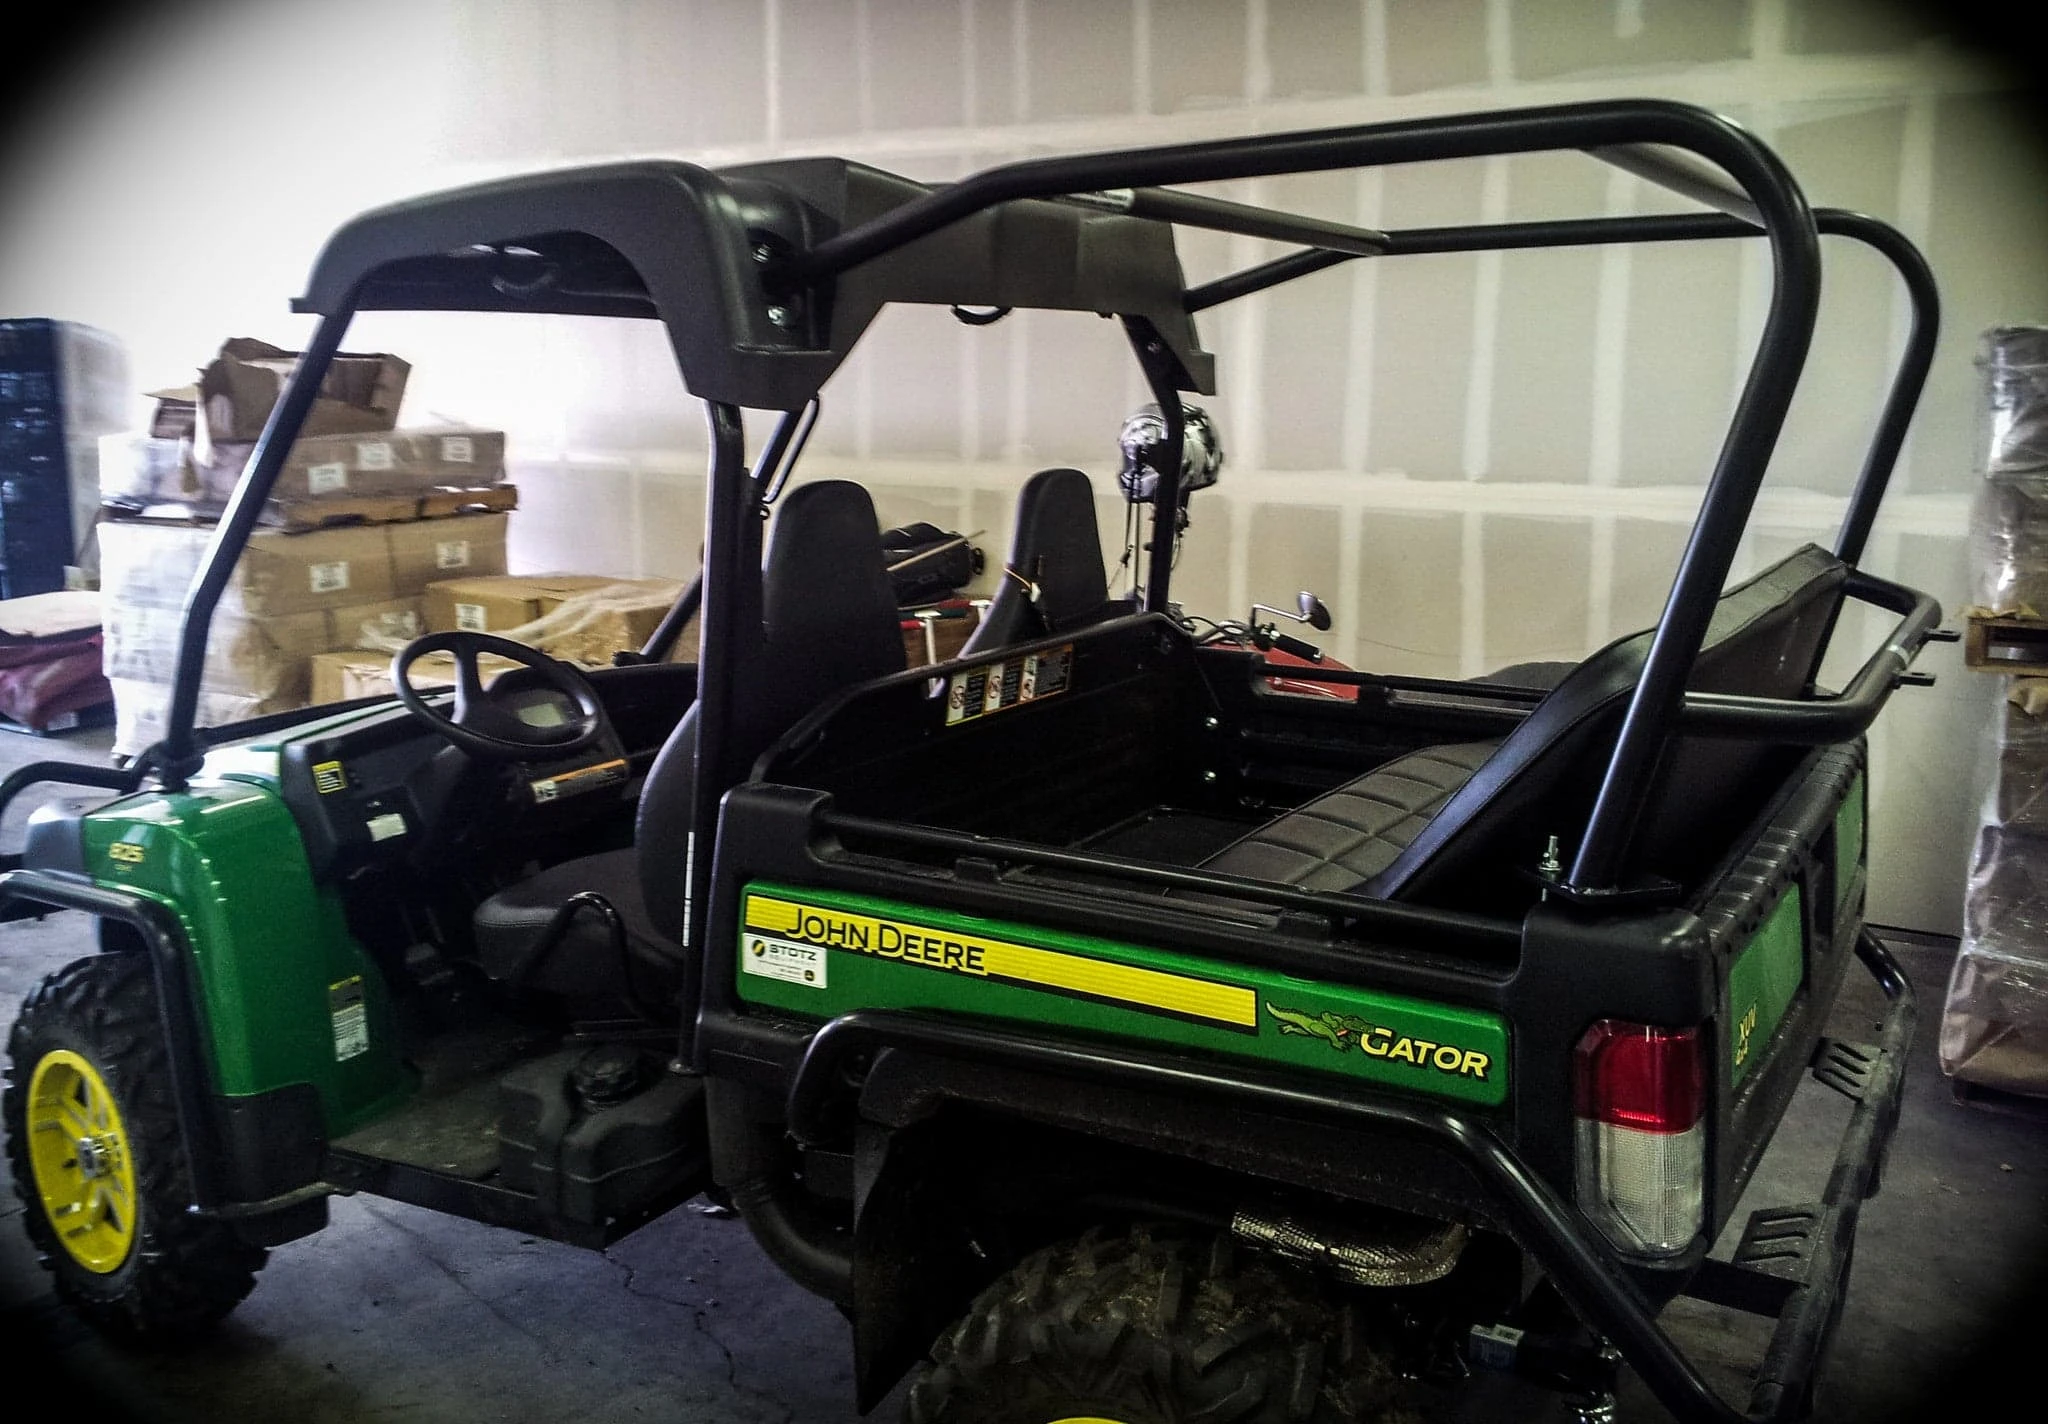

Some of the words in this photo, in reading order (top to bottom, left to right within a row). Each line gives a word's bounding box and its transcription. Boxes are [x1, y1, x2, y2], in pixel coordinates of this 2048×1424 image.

[769, 943, 817, 961] STOTZ
[786, 907, 869, 949] JOHN
[878, 923, 986, 971] DEERE
[1360, 1026, 1489, 1078] GATOR
